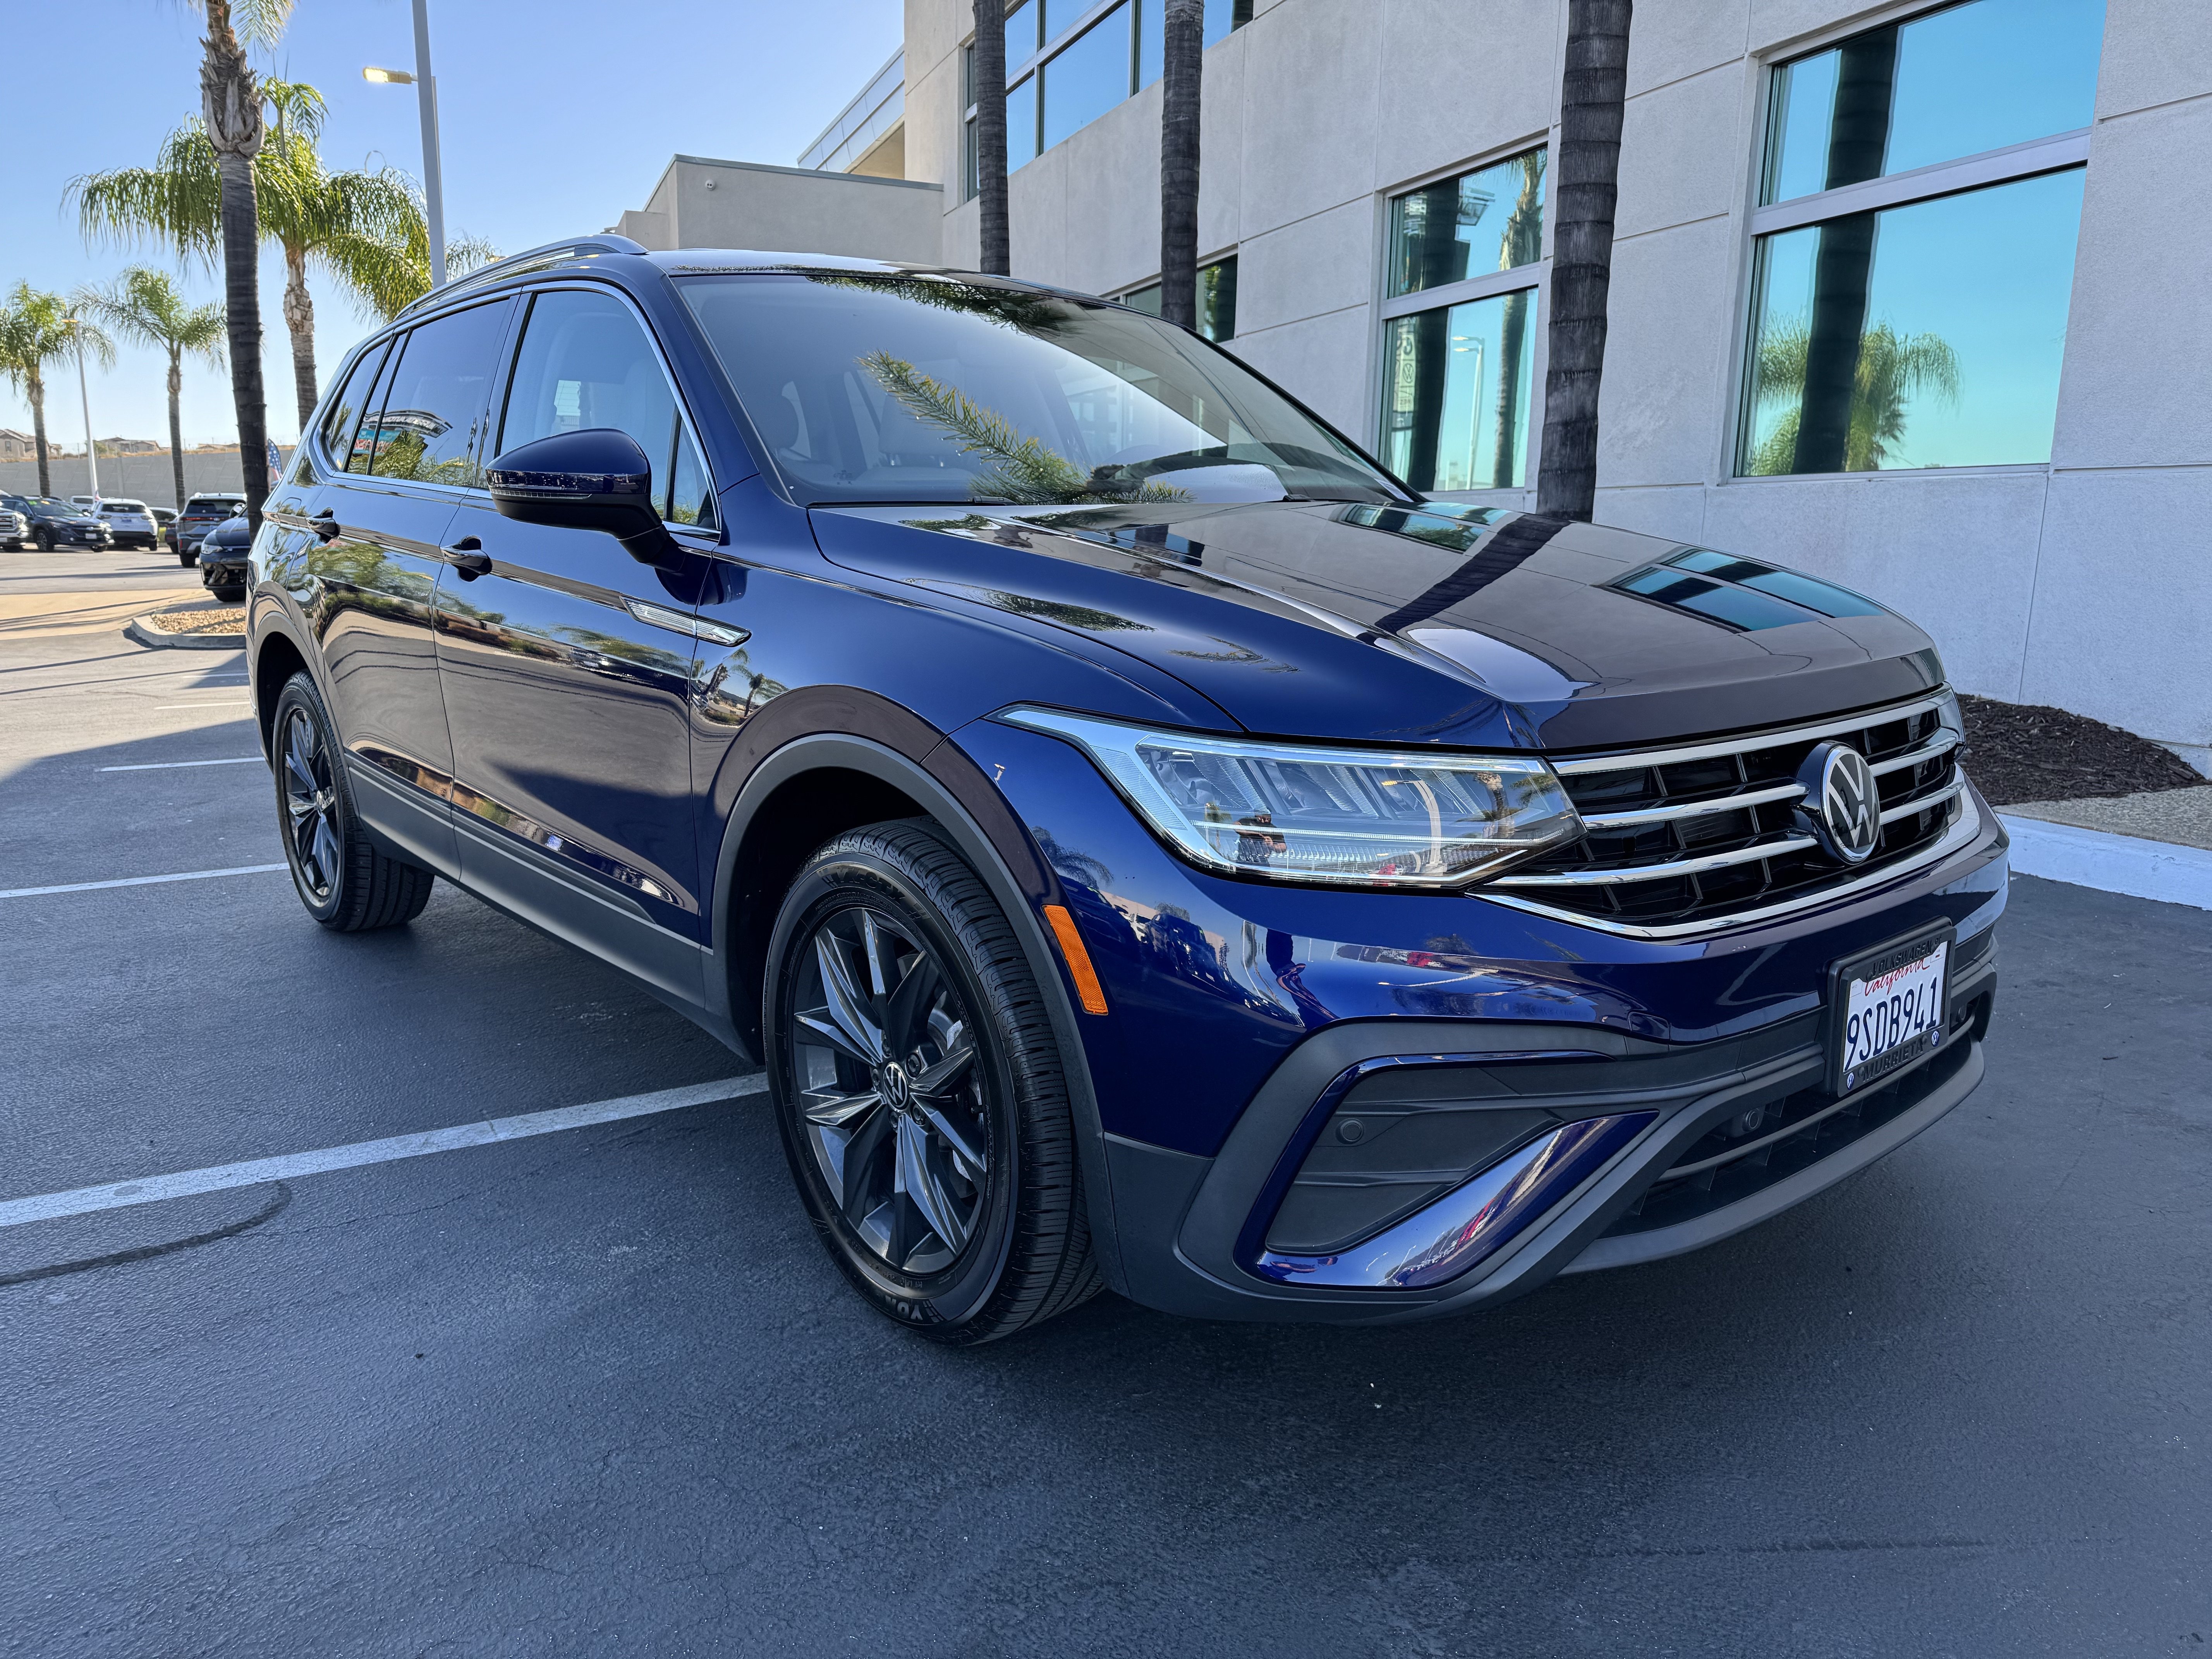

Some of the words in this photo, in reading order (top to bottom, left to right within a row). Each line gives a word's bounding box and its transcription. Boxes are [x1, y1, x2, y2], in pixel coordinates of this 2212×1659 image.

[1872, 940, 1932, 978] VOLKSWAGEN
[1844, 977, 1937, 1071] 9SDB941
[1863, 1038, 1923, 1082] MURRIETA
